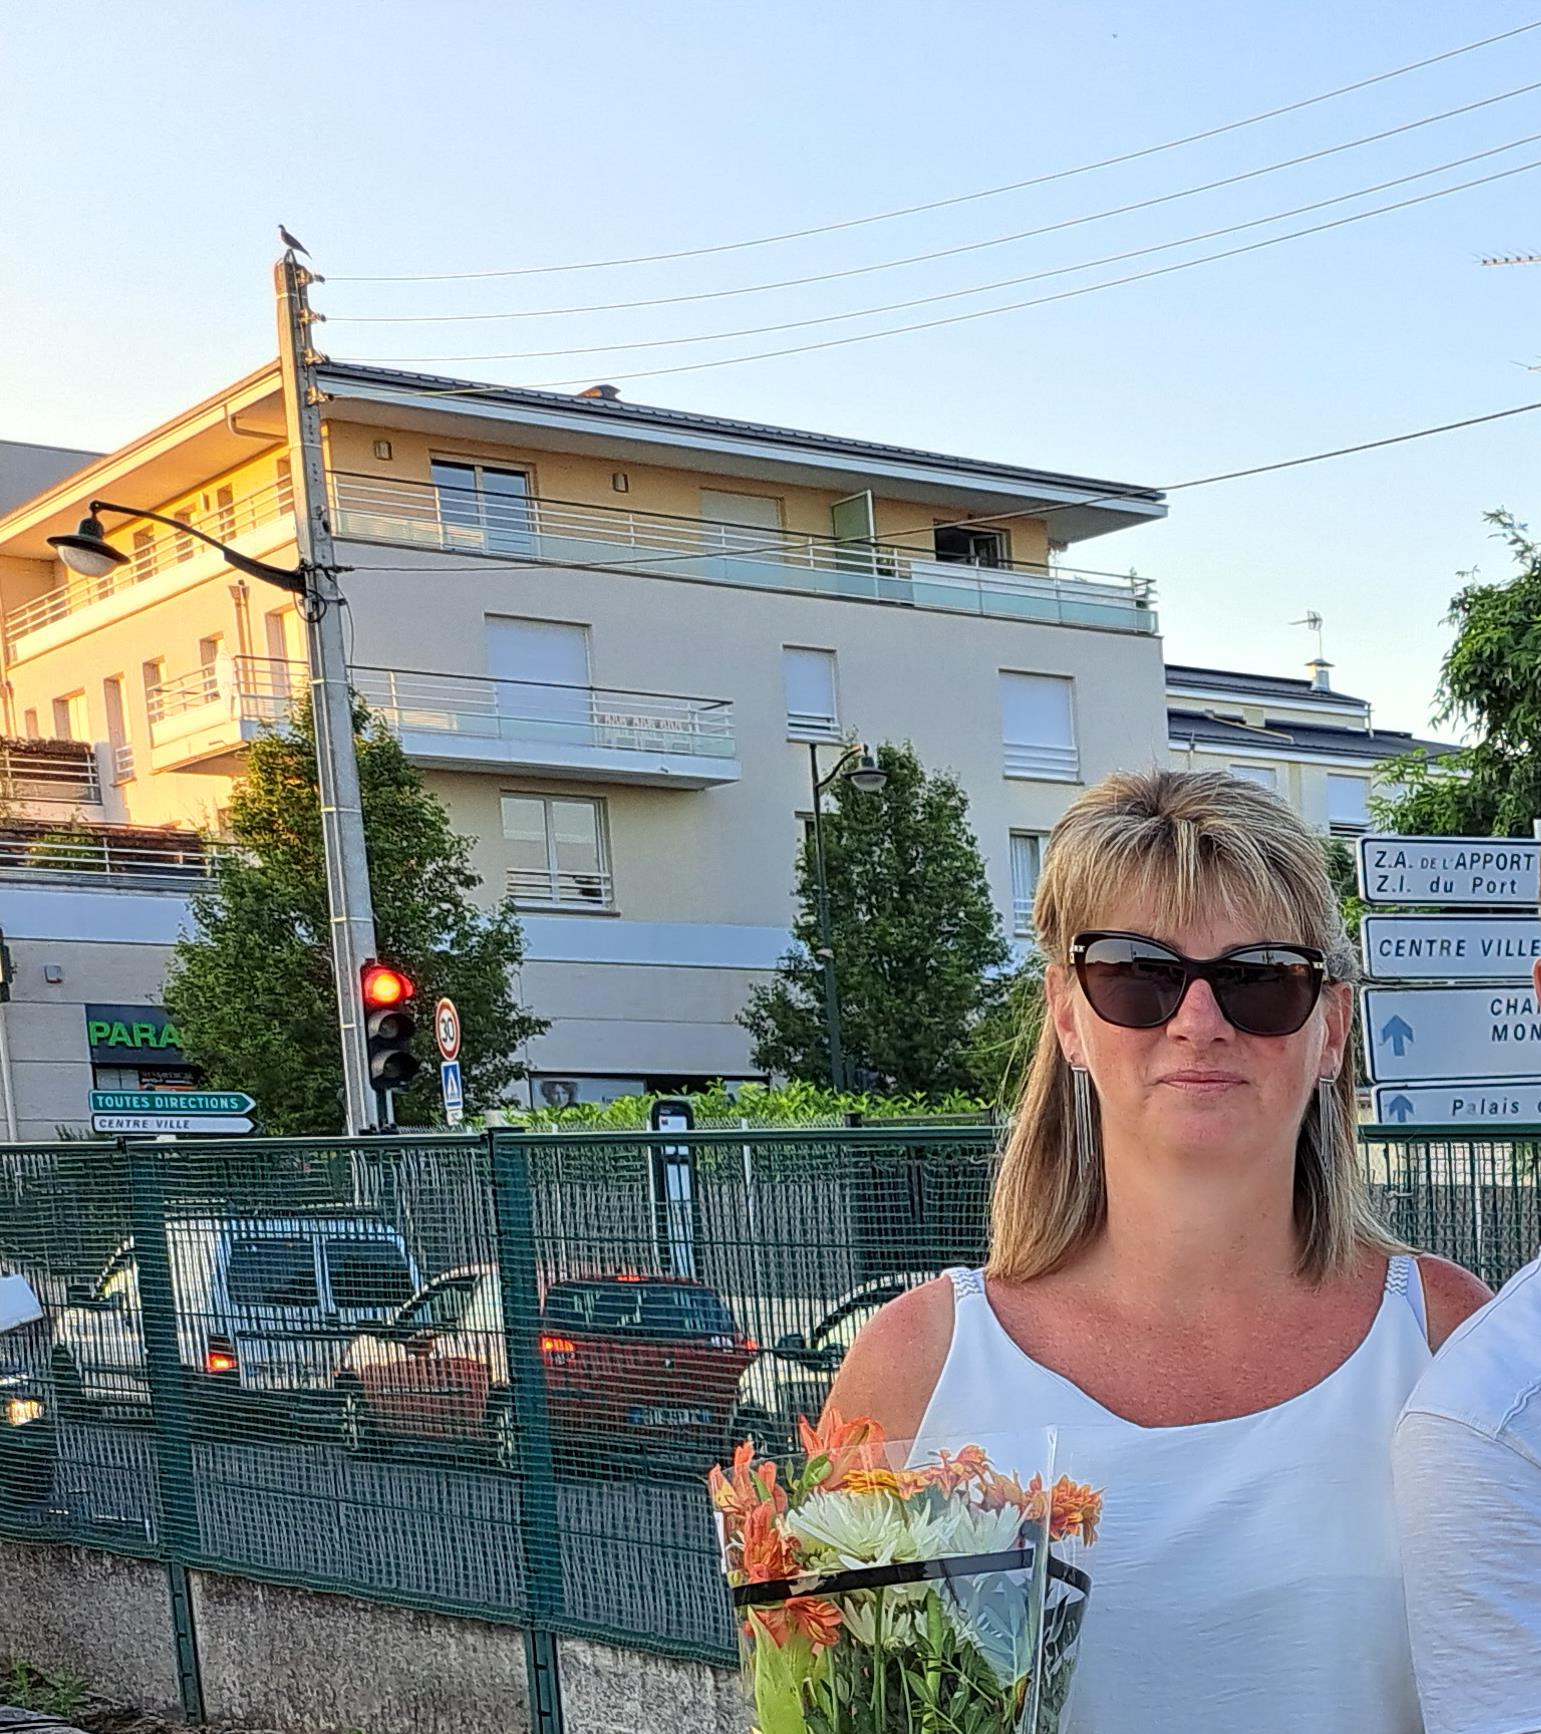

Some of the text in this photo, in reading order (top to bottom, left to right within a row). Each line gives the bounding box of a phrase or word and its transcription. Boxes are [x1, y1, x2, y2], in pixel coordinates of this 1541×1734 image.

[1374, 850, 1413, 869] Z.A.
[1420, 857, 1437, 870] DE
[1376, 875, 1517, 895] Z.I. du Port
[1379, 938, 1541, 957] CENTRE VILLE
[1490, 998, 1541, 1017] CHA
[440, 1017, 455, 1043] 30
[96, 1095, 239, 1110] TOUTES DIRECTIONS
[1452, 1096, 1520, 1117] Palais
[99, 1118, 190, 1130] CENTRE VILLE
